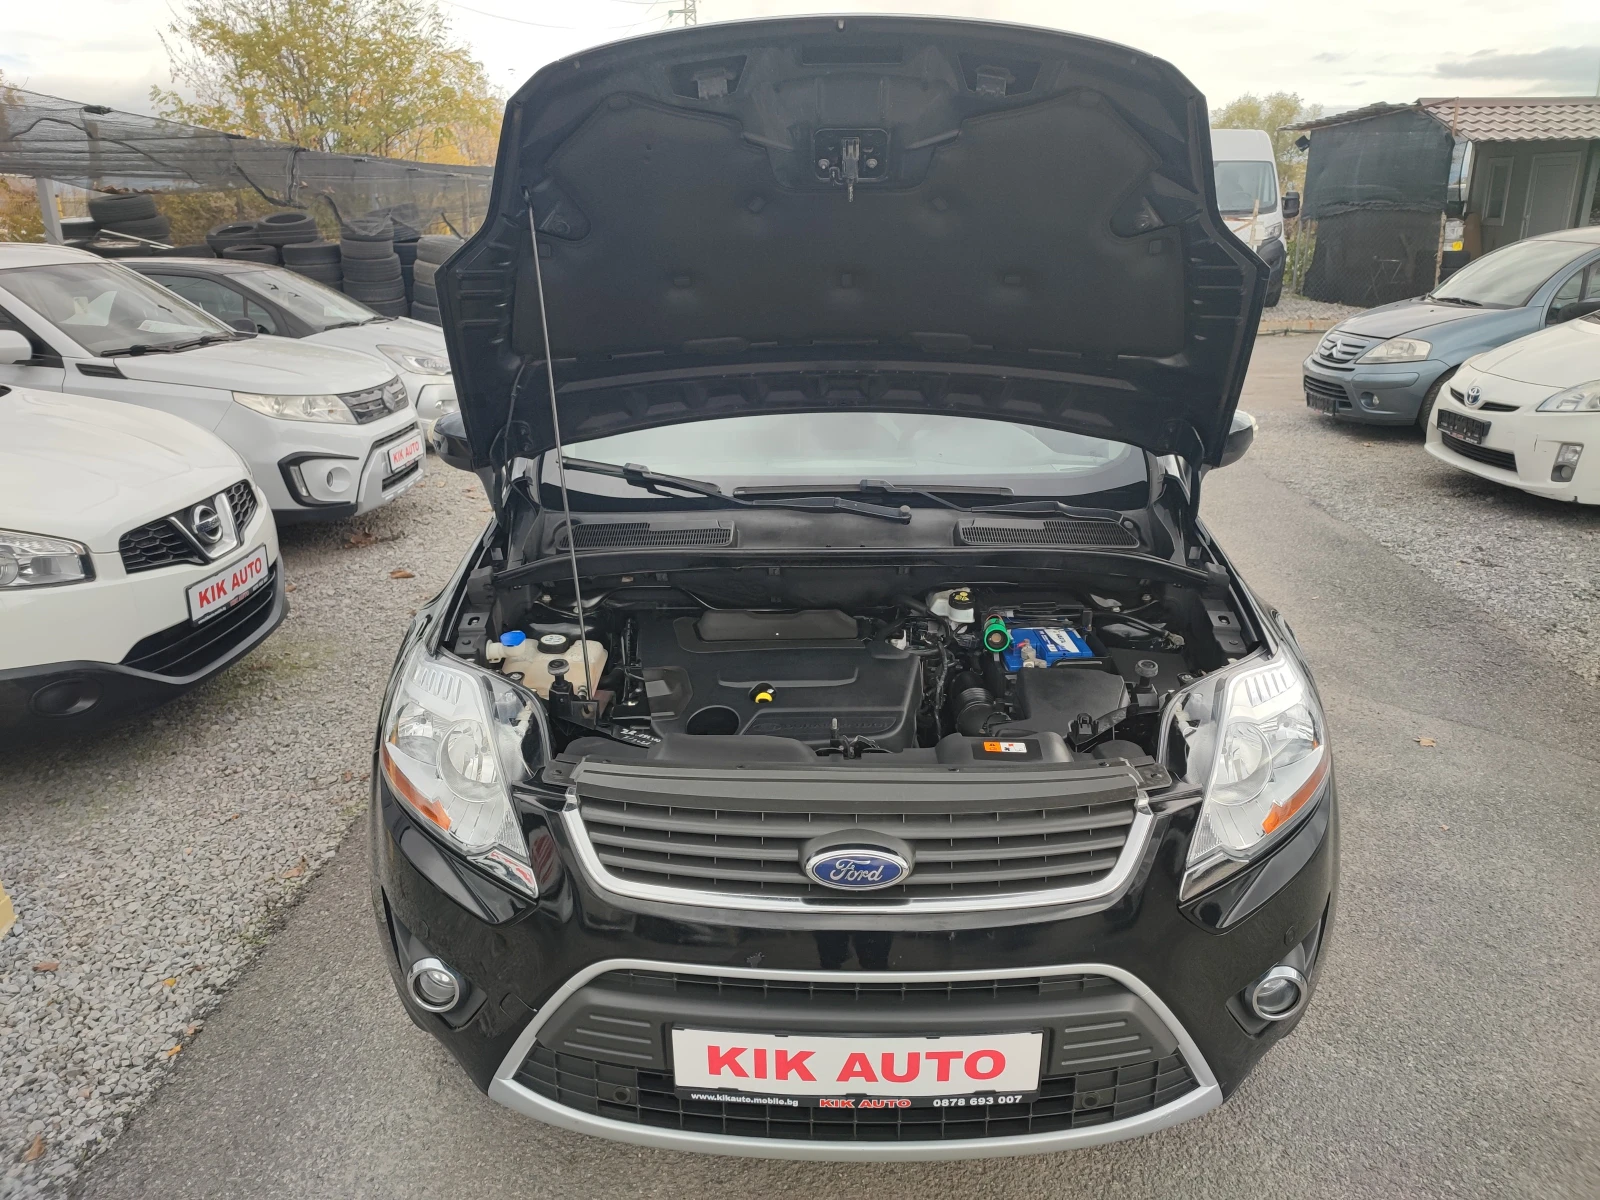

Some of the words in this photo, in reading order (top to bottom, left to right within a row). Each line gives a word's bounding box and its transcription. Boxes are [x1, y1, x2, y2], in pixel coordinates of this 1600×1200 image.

[393, 449, 404, 464] KIK
[405, 441, 420, 457] AUTO
[198, 578, 228, 609] KIK
[231, 557, 262, 592] AUTO
[830, 859, 885, 881] Ford
[707, 1045, 817, 1082] KIK
[836, 1049, 1006, 1083] AUTO
[691, 1092, 799, 1107] www.kikauto.mobile.bg
[819, 1098, 856, 1108] KIK
[858, 1099, 912, 1109] AUTO
[933, 1099, 966, 1107] 0878
[969, 1097, 994, 1106] 693
[997, 1095, 1023, 1105] 007
